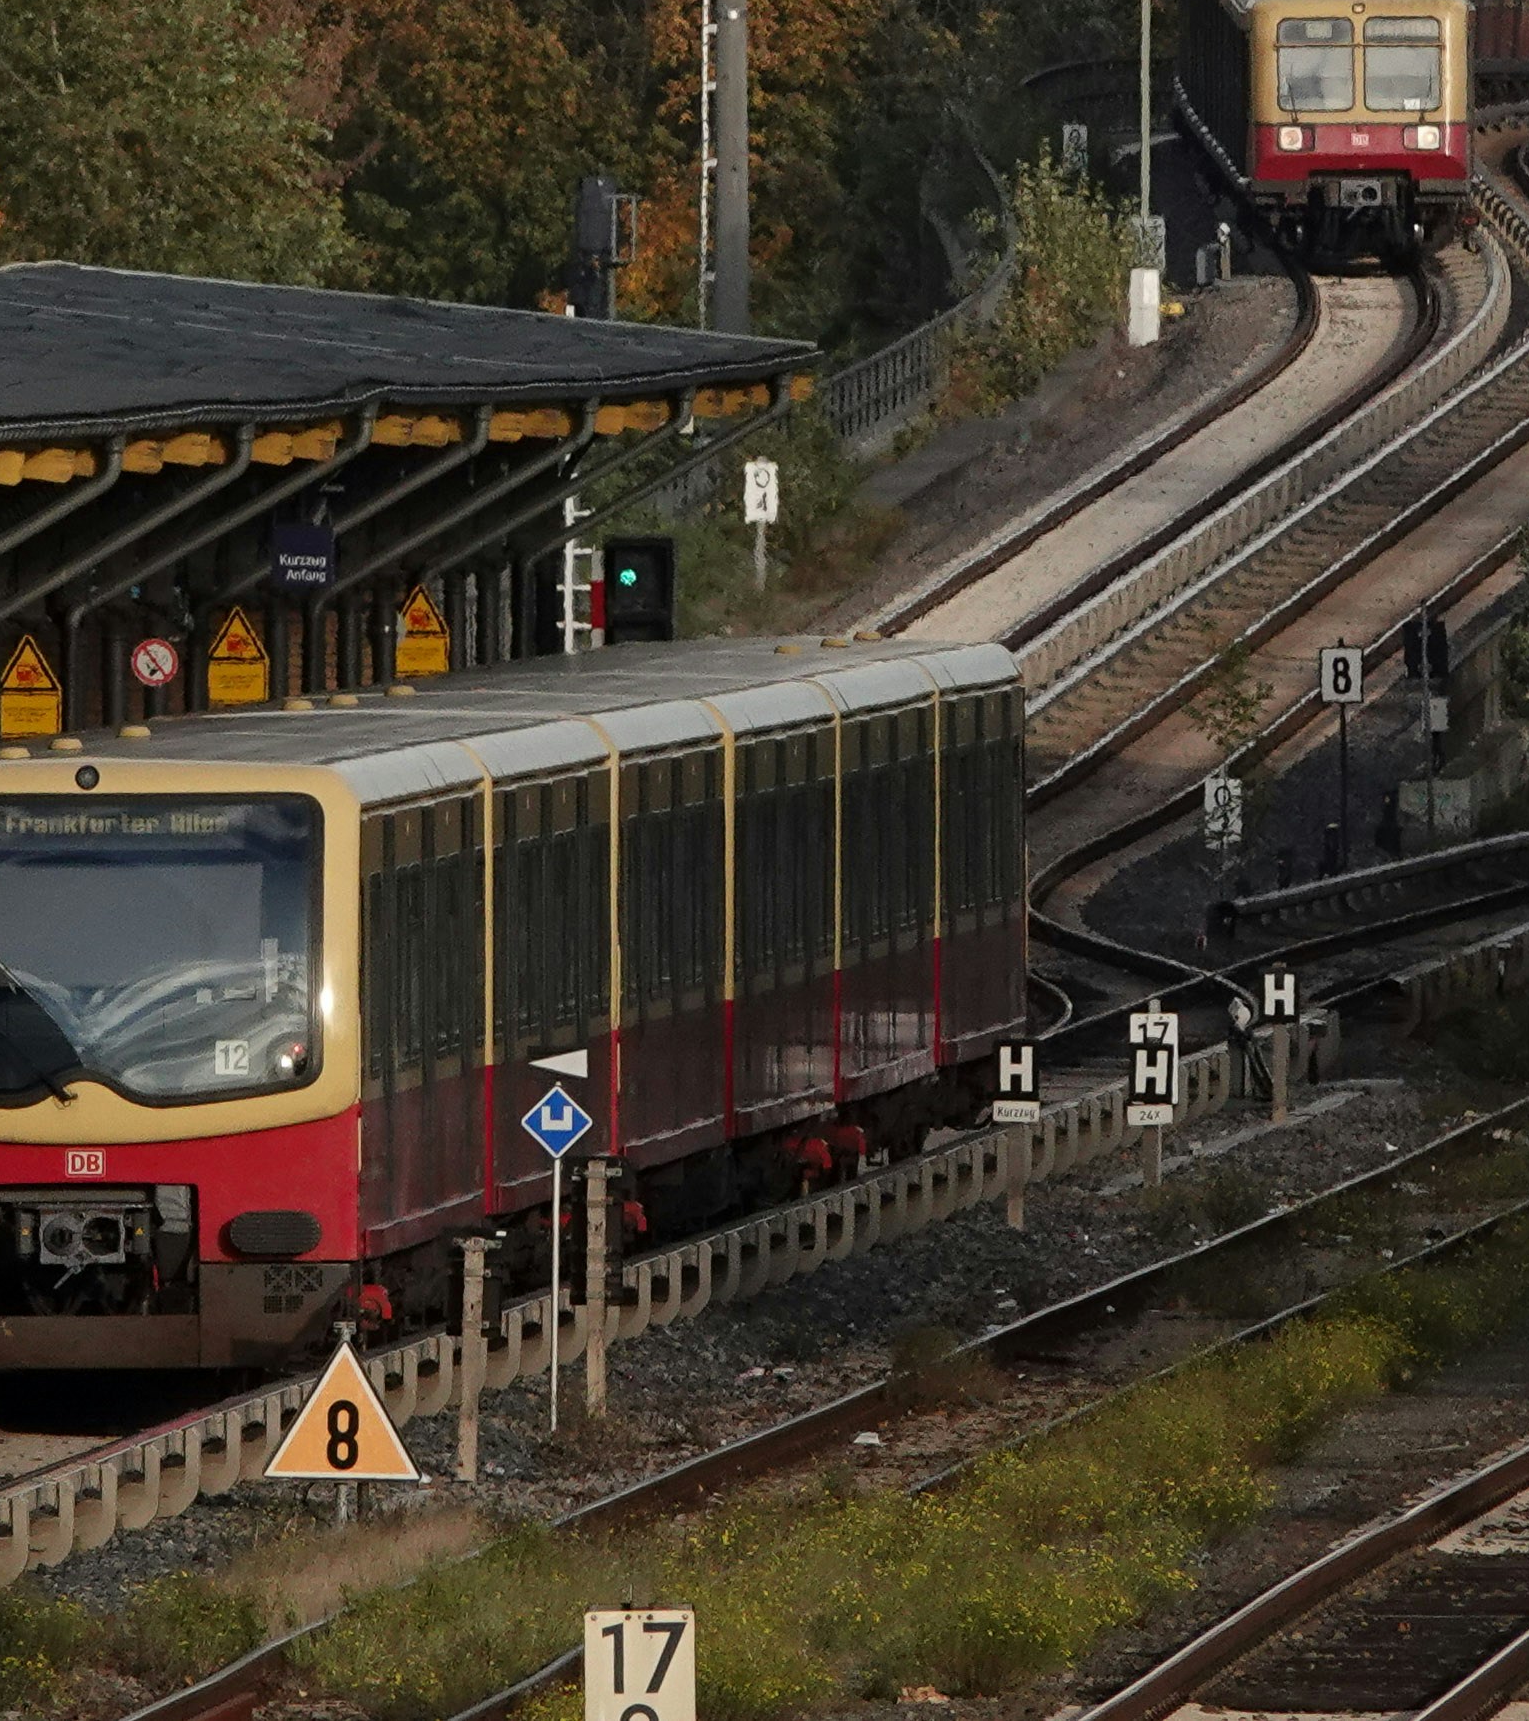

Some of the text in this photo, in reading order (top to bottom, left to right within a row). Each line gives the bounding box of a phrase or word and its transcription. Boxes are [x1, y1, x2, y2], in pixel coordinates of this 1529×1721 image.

[1332, 656, 1352, 694] 8
[1264, 973, 1295, 1016] H
[1138, 1022, 1170, 1044] 17
[219, 1044, 249, 1071] 12
[999, 1046, 1033, 1092] H
[1135, 1050, 1168, 1095] H
[71, 1154, 101, 1173] DB
[327, 1399, 359, 1470] 8
[602, 1622, 687, 1694] 17
